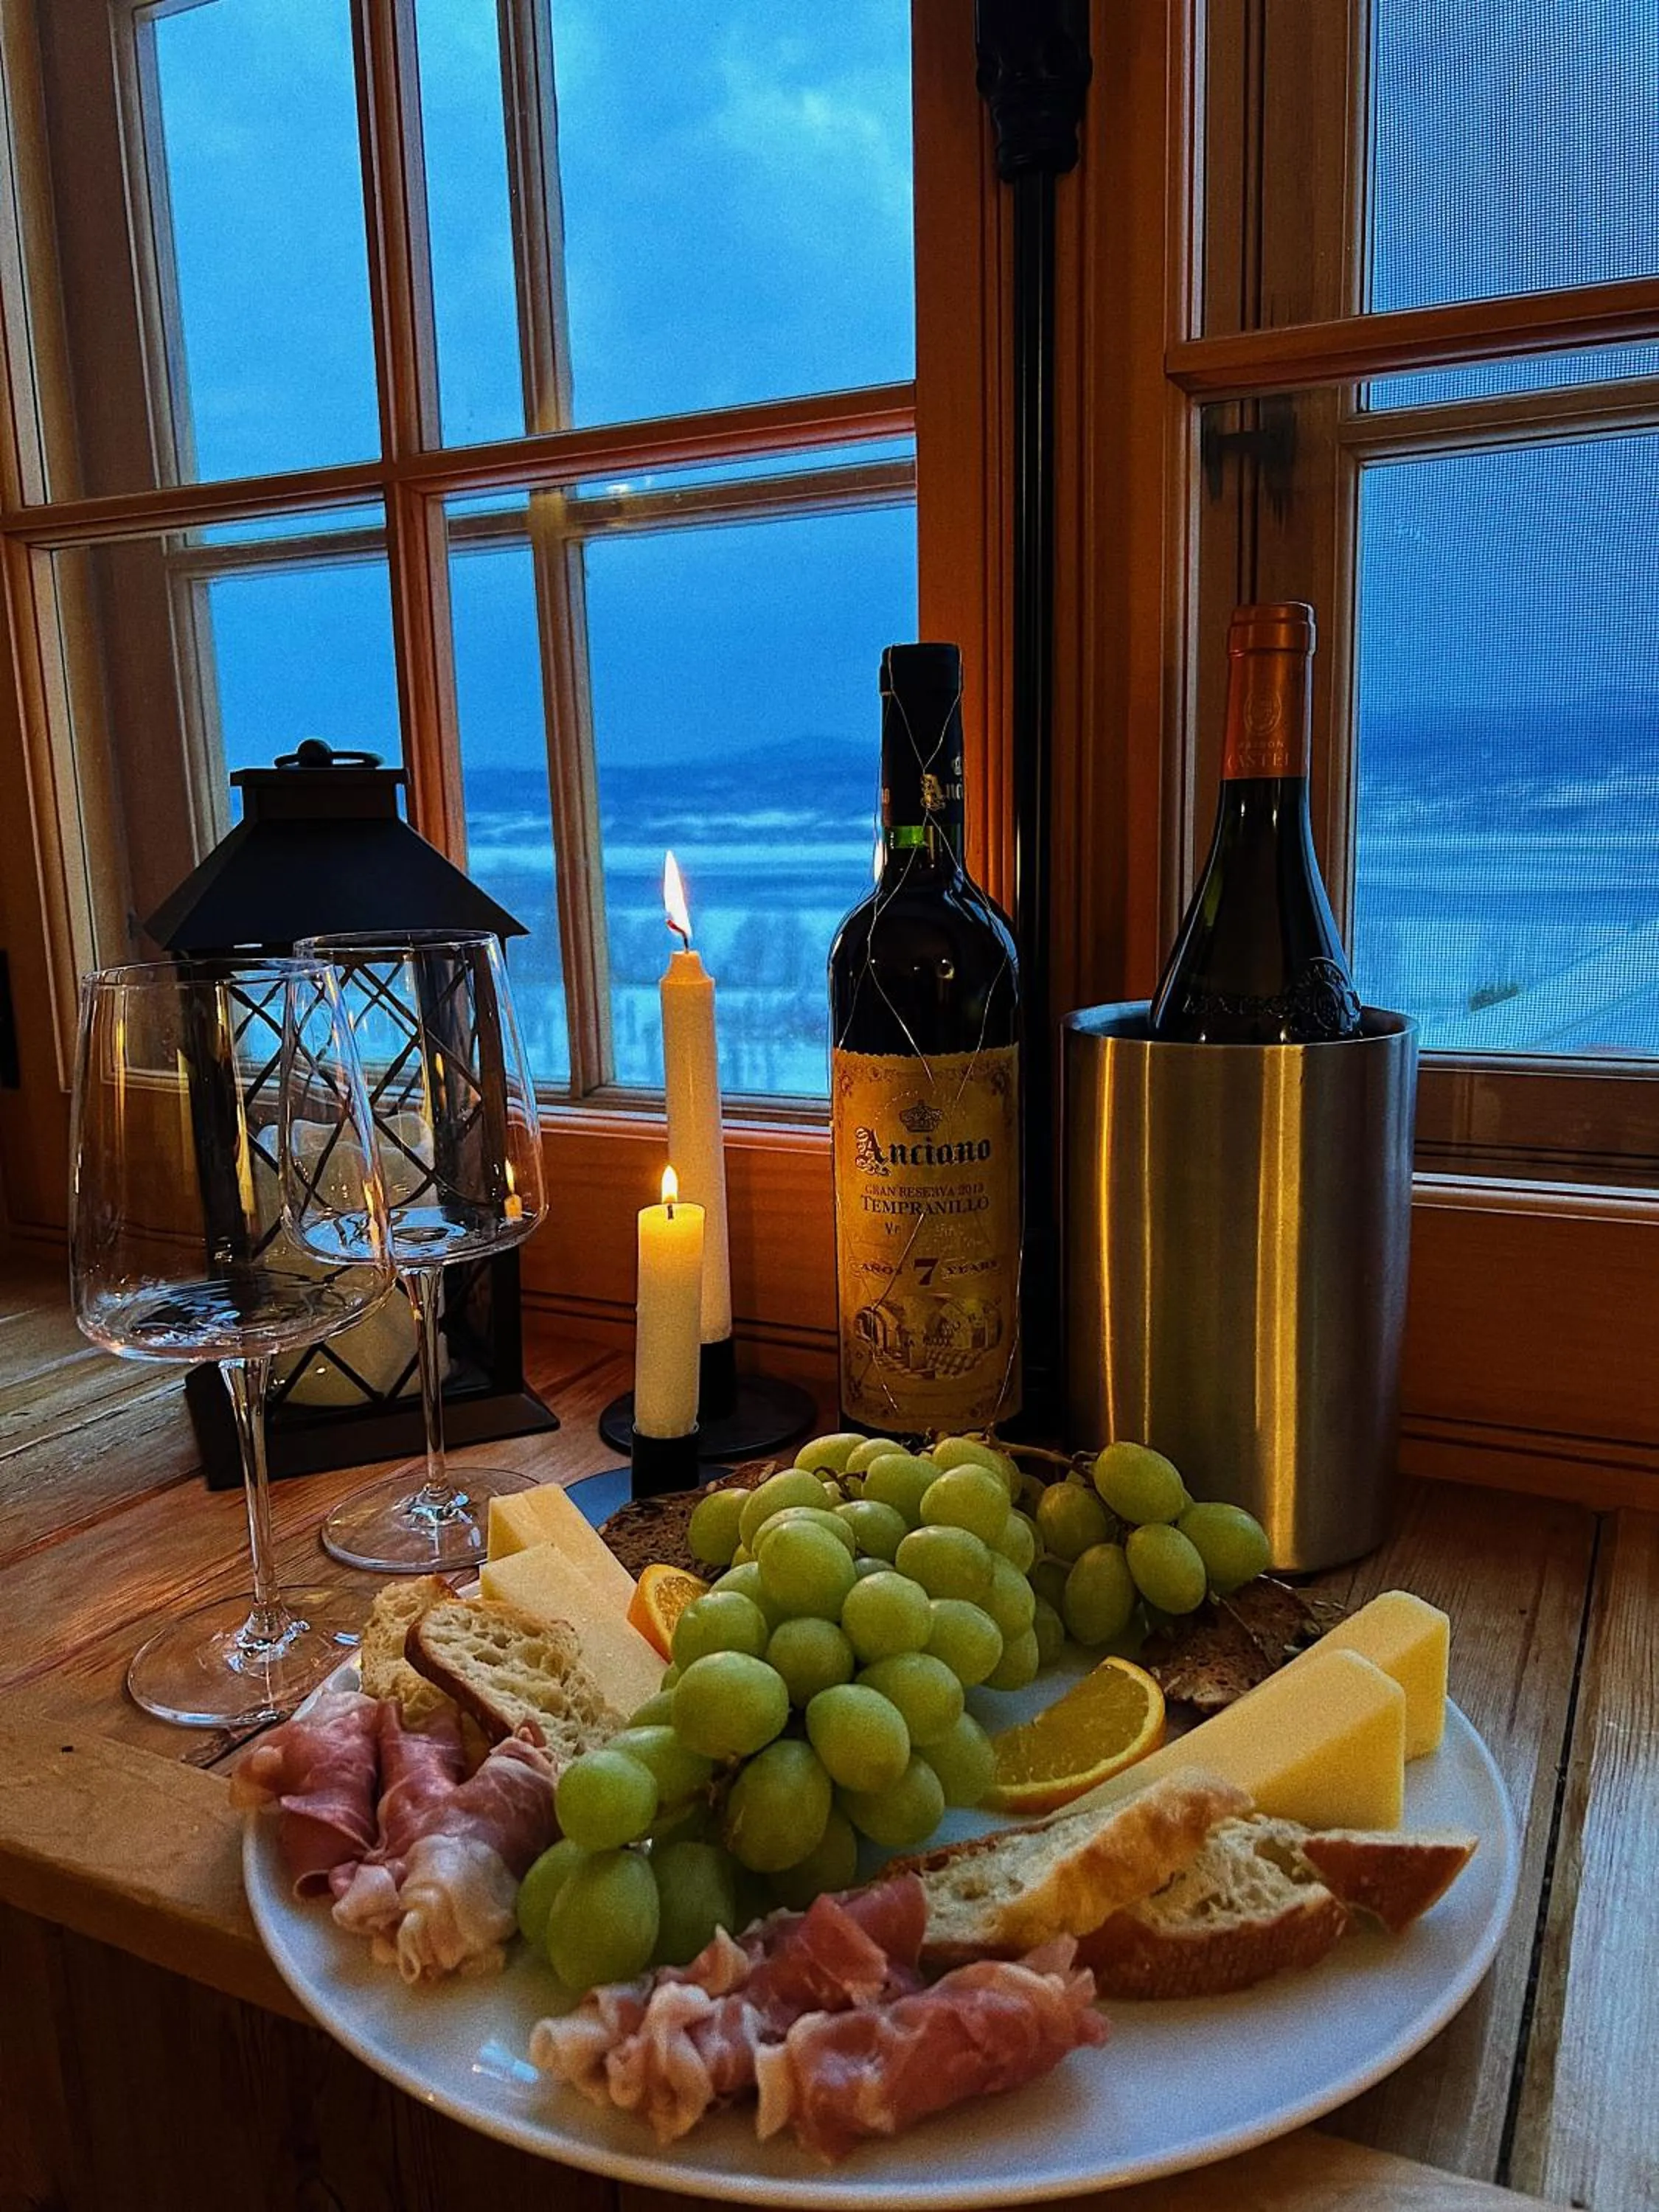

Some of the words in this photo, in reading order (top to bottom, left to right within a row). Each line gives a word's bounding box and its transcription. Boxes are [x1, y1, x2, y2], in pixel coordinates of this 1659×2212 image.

[855, 1127, 990, 1176] Anciano
[864, 1183, 897, 1197] GRAN
[899, 1185, 955, 1198] RESERVA
[861, 1194, 990, 1215] TEMPRANILLO
[914, 1257, 939, 1286] 7
